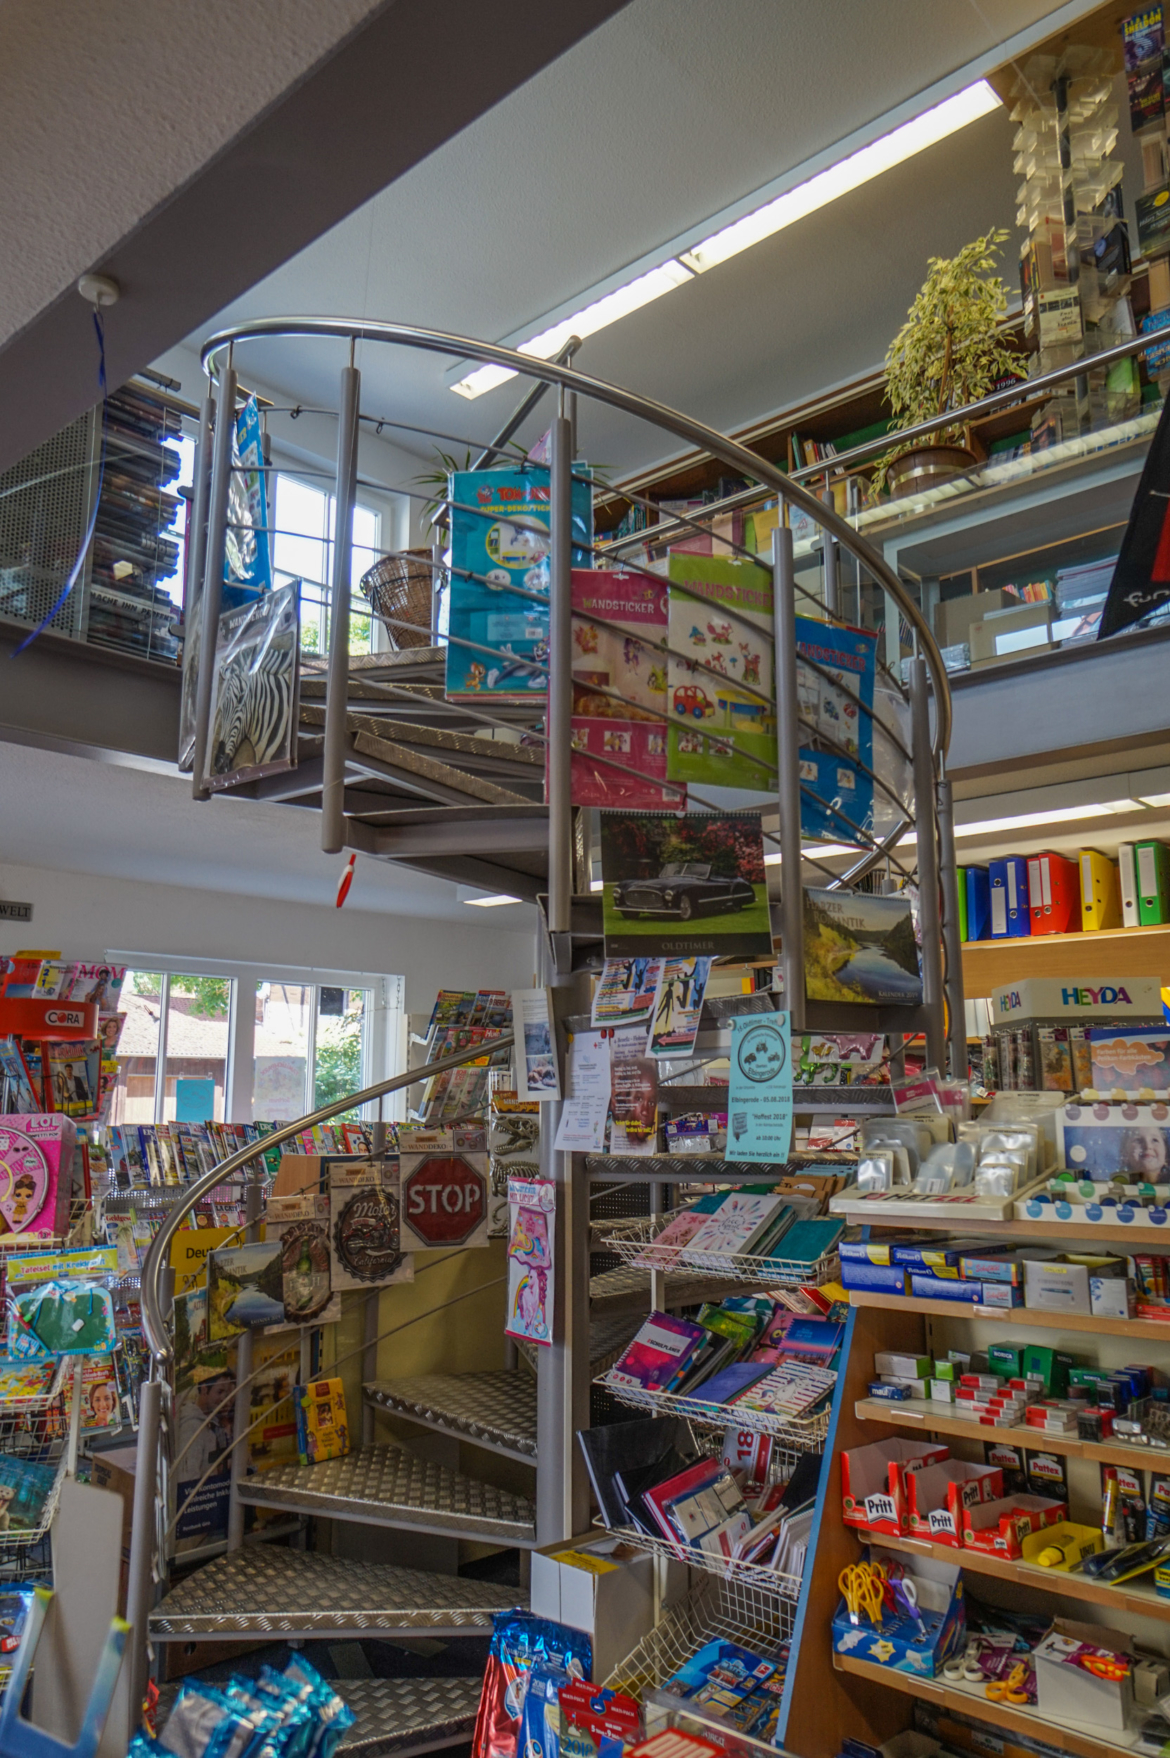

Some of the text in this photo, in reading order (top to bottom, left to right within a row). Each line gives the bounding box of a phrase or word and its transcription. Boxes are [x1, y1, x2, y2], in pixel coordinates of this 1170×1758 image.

[1124, 12, 1162, 36] SHELDON
[996, 377, 1016, 391] 1996
[497, 486, 522, 501] TOM
[583, 597, 654, 614] WANDSTICKER
[806, 898, 844, 915] HARZER
[813, 912, 866, 929] ROMANTIK
[661, 941, 714, 950] OLDTIMER
[78, 963, 128, 980] MOM
[878, 990, 904, 999] KALENDER
[1061, 986, 1133, 1006] HEYDA
[1000, 991, 1022, 1012] HEYDA
[48, 1011, 80, 1025] CORA
[1117, 1048, 1126, 1056] für
[732, 1096, 759, 1104] Elbingerode
[30, 1116, 60, 1128] LOL
[409, 1184, 480, 1214] STOP
[274, 1210, 310, 1218] WANDDEKO
[353, 1202, 398, 1220] Motor
[842, 1250, 860, 1258] Pelikan
[896, 1252, 916, 1261] Pelikan
[354, 1256, 394, 1267] California
[21, 1264, 50, 1275] Tafelset
[52, 1262, 64, 1270] mit
[907, 1267, 927, 1275] Pelikan
[993, 1351, 1012, 1360] NORICA
[1057, 1356, 1072, 1364] NORICA
[1083, 1374, 1100, 1382] NORICA
[872, 1387, 888, 1396] maul
[737, 1431, 754, 1460] 18
[991, 1452, 1017, 1464] Pattex
[1032, 1462, 1060, 1476] Pattex
[964, 1484, 978, 1505] Pritt
[868, 1499, 894, 1516] Pritt
[931, 1514, 952, 1529] Pritt
[1018, 1520, 1030, 1538] Pritt
[1080, 1543, 1096, 1558] UHU
[575, 1681, 598, 1693] MULTI-PACK
[562, 1692, 585, 1703] MULTI-PACK
[610, 1706, 635, 1717] MULTI-PACK
[591, 1724, 596, 1732] 5
[562, 1738, 593, 1756] 2018
